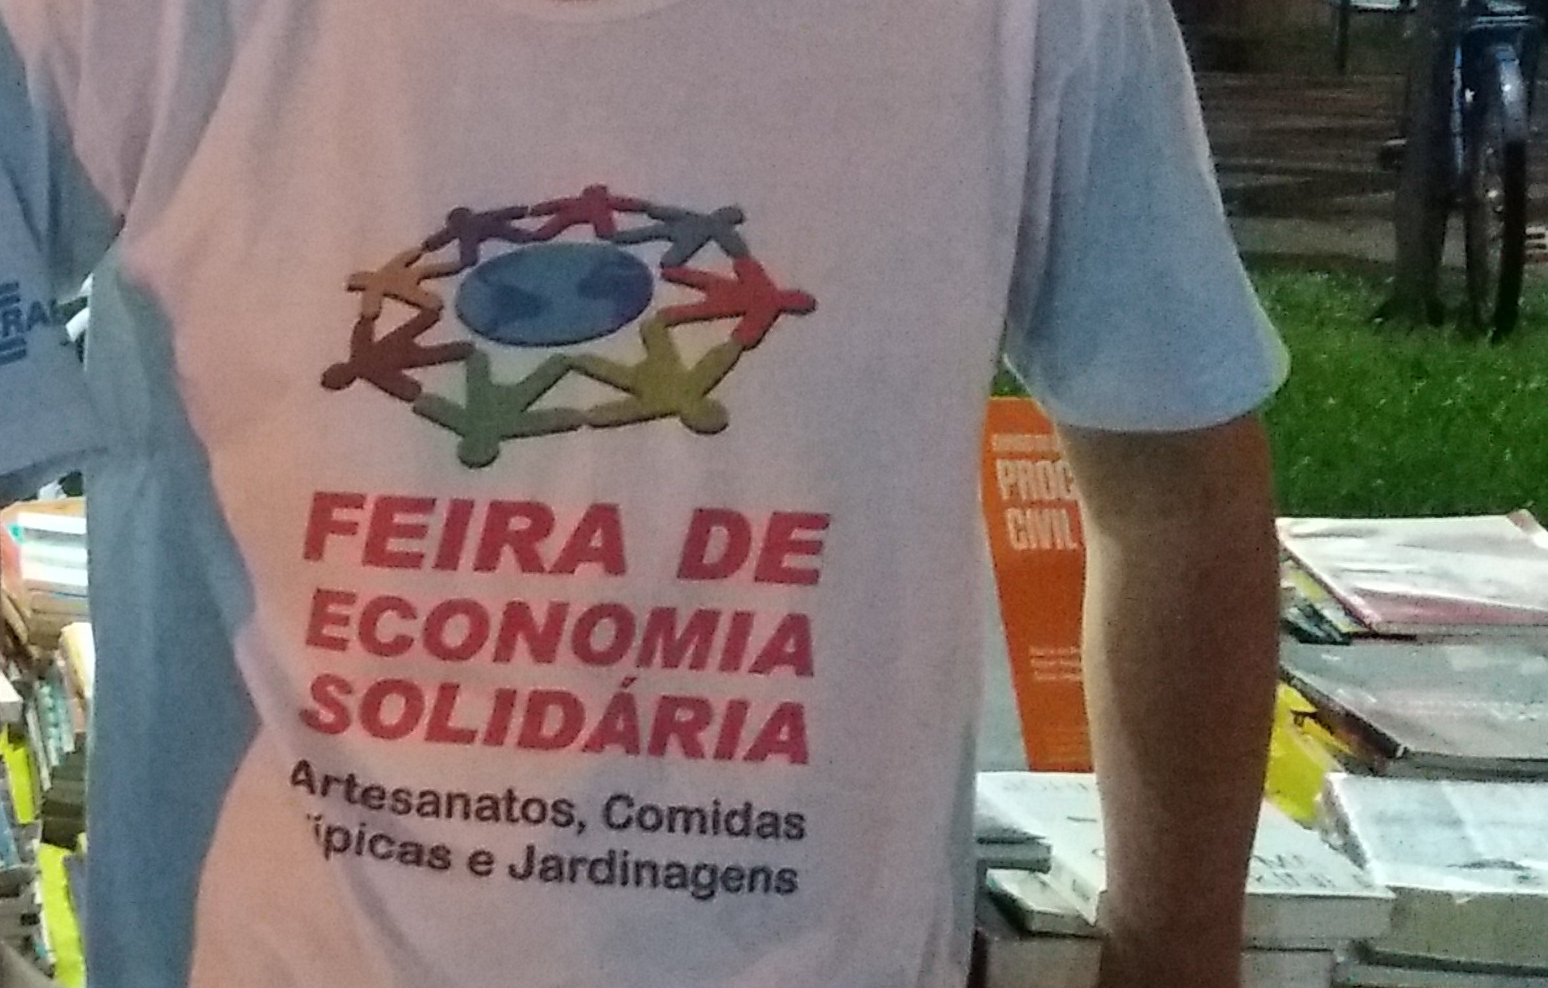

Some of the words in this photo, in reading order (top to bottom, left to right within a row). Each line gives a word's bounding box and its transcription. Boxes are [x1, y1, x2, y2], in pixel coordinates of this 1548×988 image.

[302, 490, 628, 577] FEIRA
[676, 506, 832, 586] DE
[303, 587, 816, 679] ECONOMIA
[298, 673, 810, 766] SOLIDÁRIA
[289, 758, 588, 836] Artesanatos,
[600, 793, 807, 841] Comidas
[467, 848, 495, 878] e
[508, 844, 800, 900] Jardinagens
